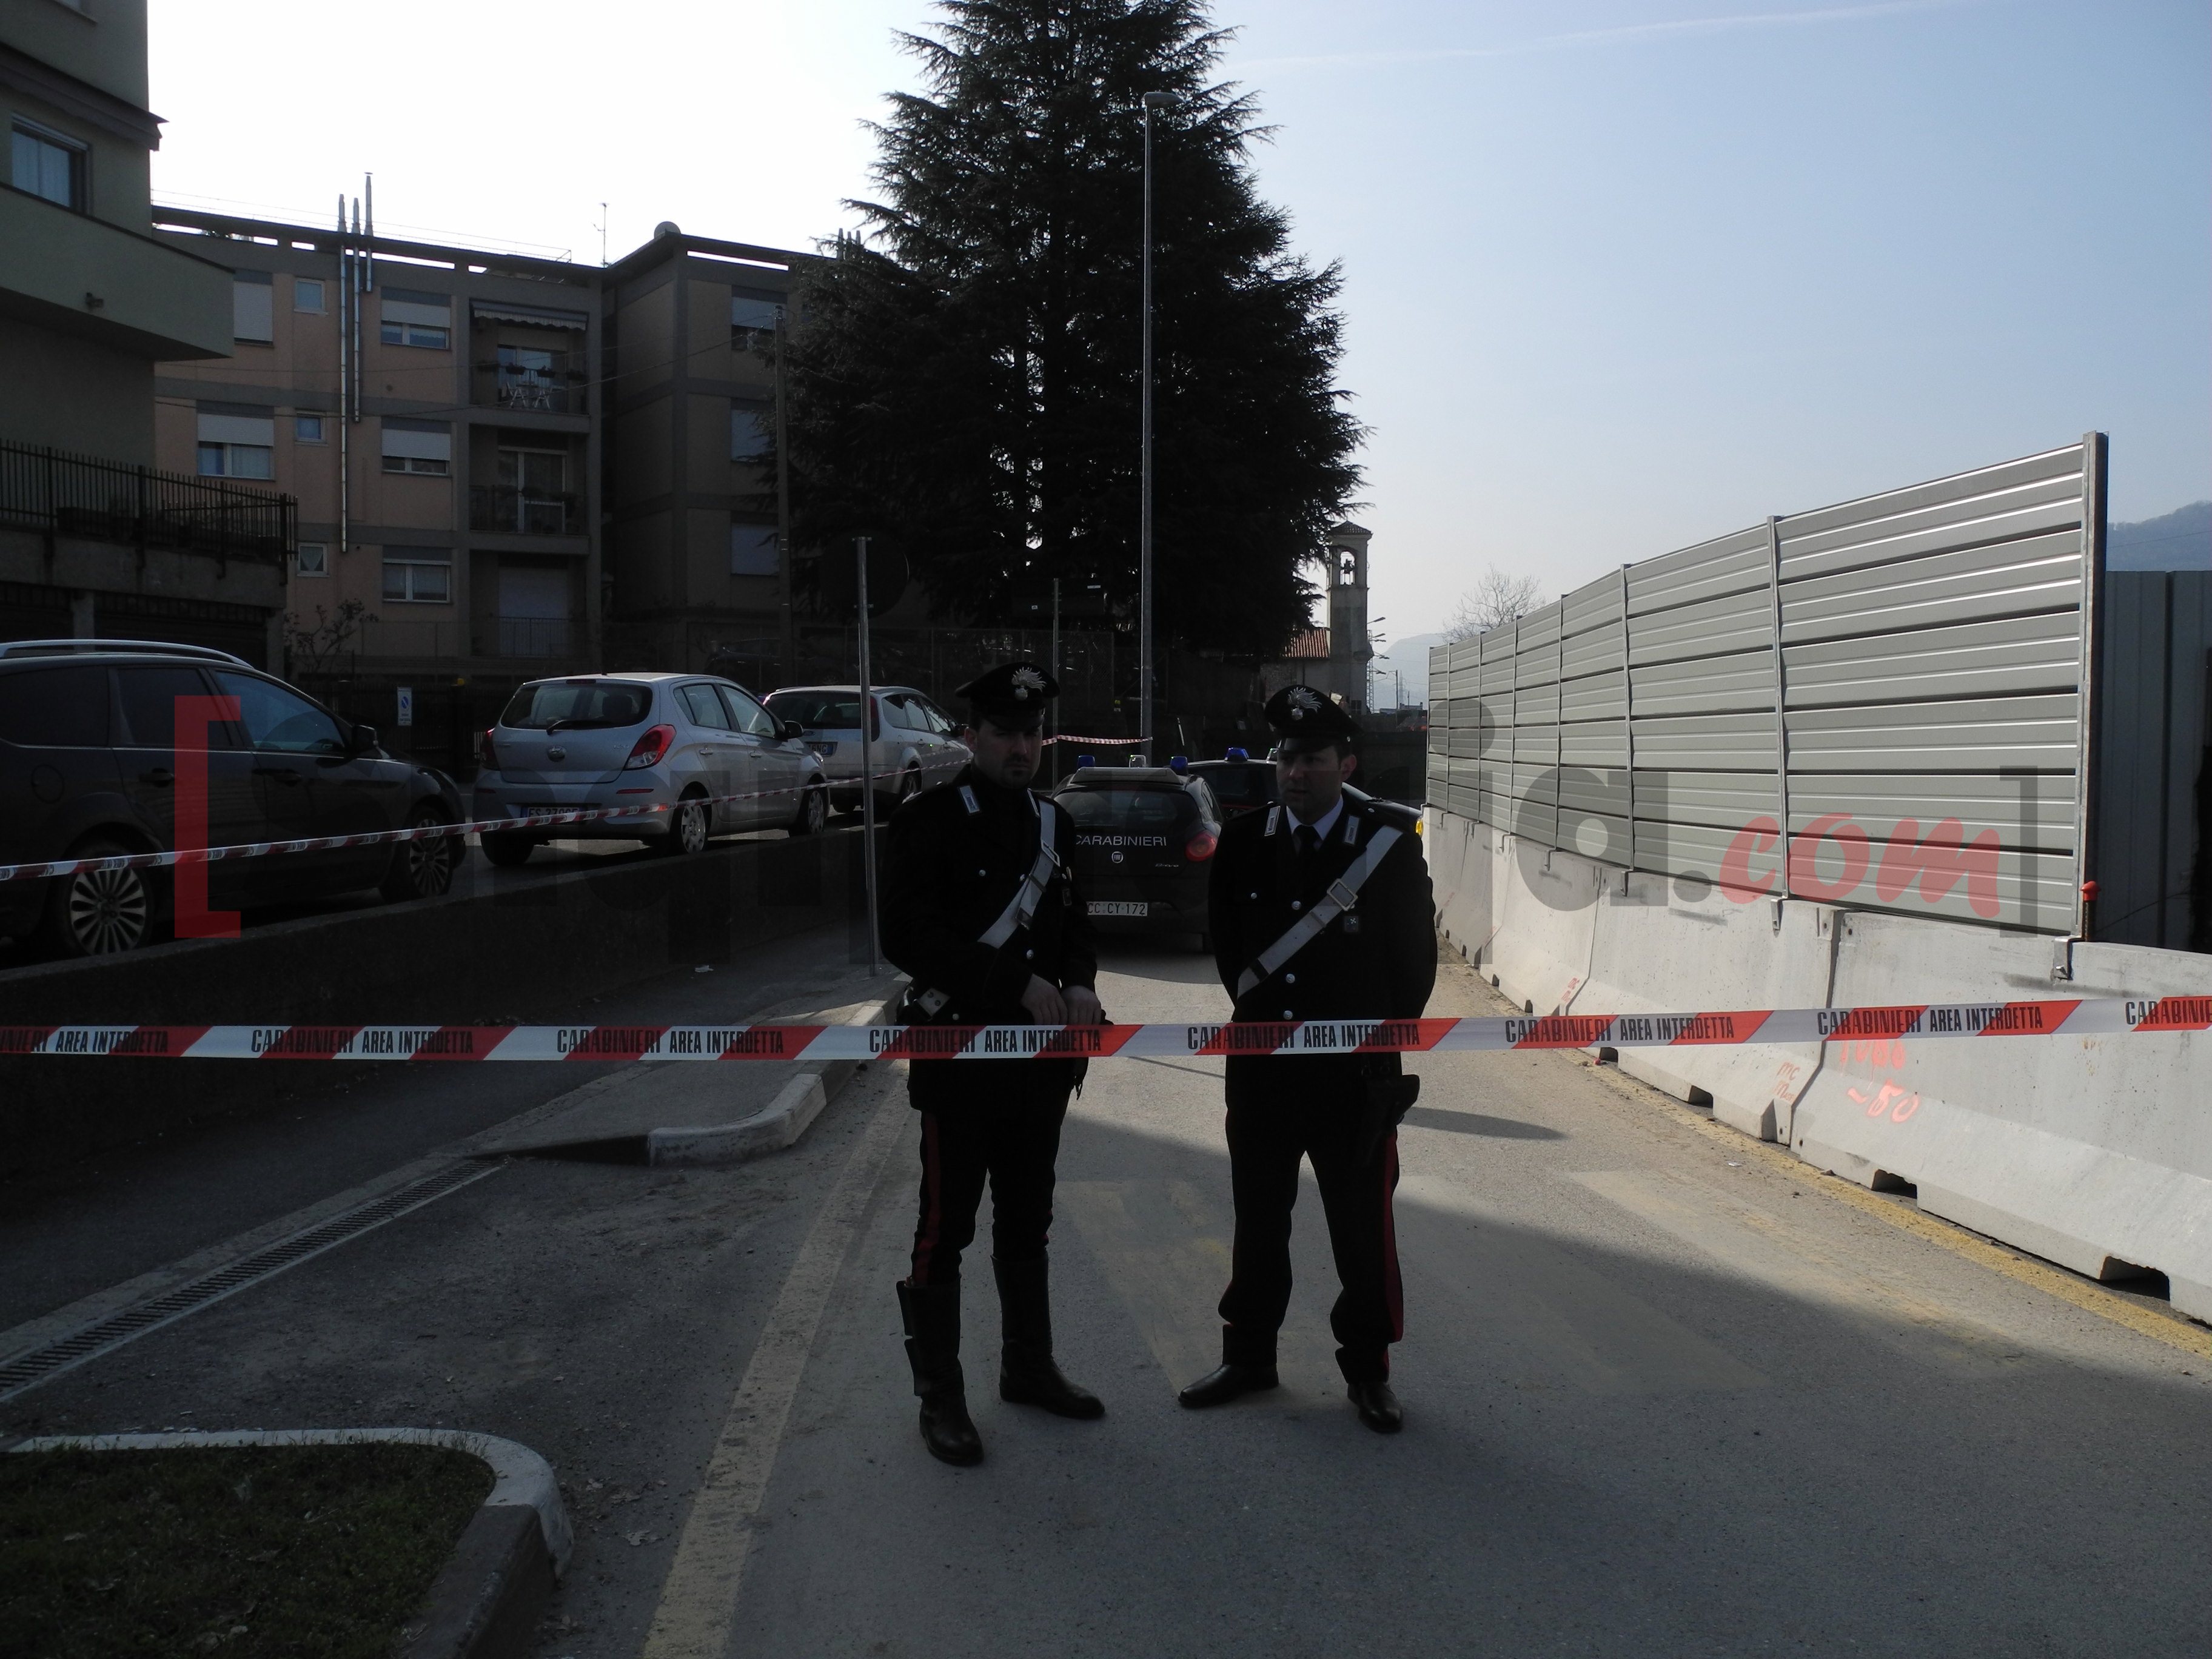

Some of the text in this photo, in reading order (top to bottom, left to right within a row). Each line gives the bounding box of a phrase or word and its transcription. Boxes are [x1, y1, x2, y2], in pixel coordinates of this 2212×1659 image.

[1076, 835, 1167, 846] CARABINIERI
[1108, 903, 1120, 914] CY
[1127, 903, 1145, 914] 172
[1505, 1016, 1734, 1043] CARABINIERI AREA INTERDETTA
[1817, 1006, 2043, 1035] CARABINIERI AREA INTERDETTA
[56, 1031, 88, 1052] AREA
[93, 1031, 169, 1053] INTERDETTA
[251, 1030, 474, 1053] CARABINIERI AREA INTERDETTA
[557, 1030, 783, 1053] CARABINIERI AREA INTERDETTA
[870, 1029, 1101, 1053] CARABINIERI AREA INTERDETTA
[1187, 1023, 1420, 1050] CARABINIERI AREA INTERDETTA
